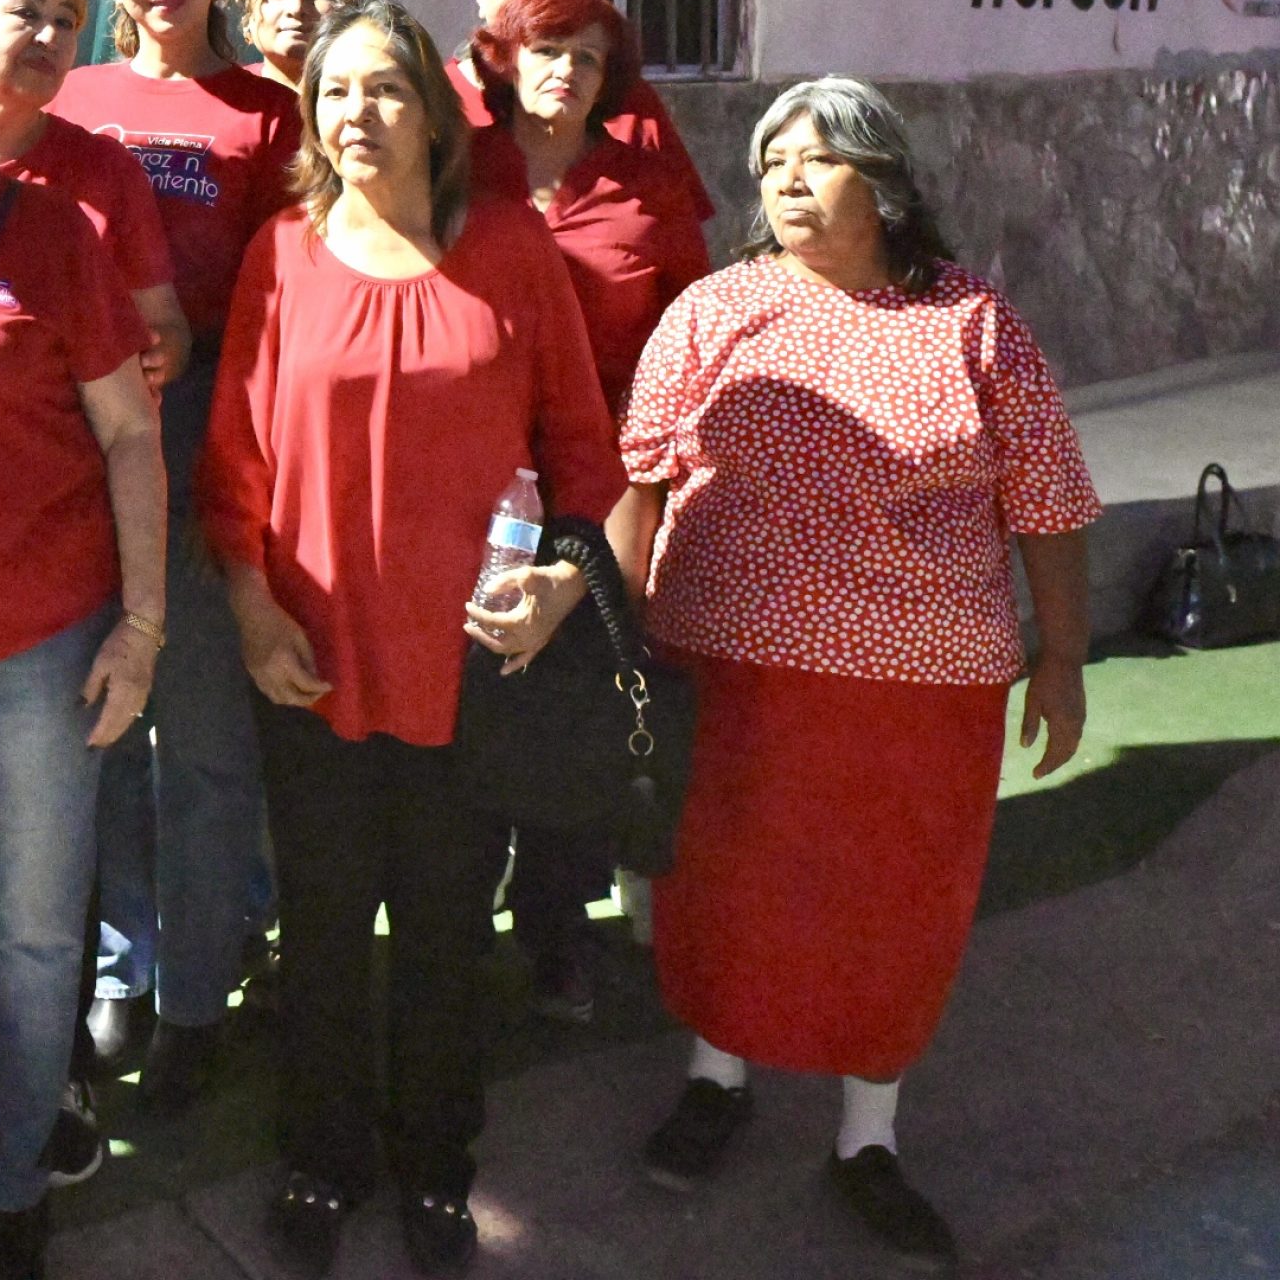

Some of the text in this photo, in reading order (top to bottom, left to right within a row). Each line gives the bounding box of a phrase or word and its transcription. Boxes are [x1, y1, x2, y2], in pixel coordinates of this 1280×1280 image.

[147, 136, 203, 149] Vida Plena
[142, 166, 219, 198] ntento
